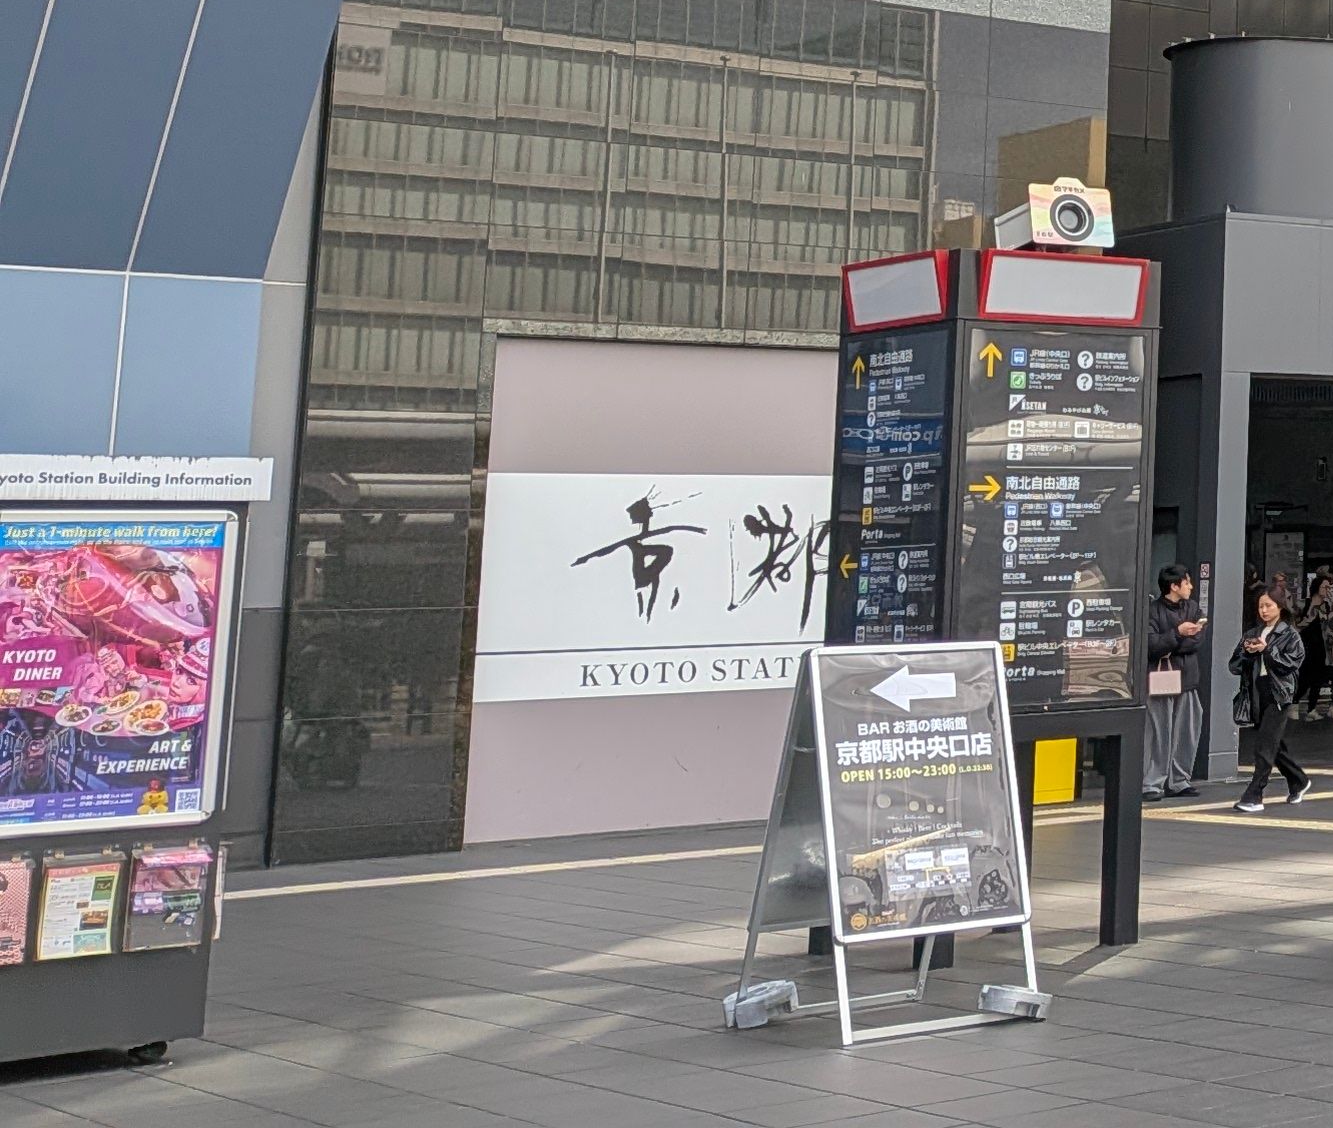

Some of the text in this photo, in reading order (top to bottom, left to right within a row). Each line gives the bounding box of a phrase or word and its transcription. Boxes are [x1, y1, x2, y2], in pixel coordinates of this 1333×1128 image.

[0, 472, 252, 488] yoto Station Building Information
[1006, 476, 1080, 491] 南北自由通路
[3, 649, 57, 664] KYOTO
[13, 667, 63, 682] DINER
[579, 655, 801, 688] KYOTO STAT
[857, 716, 968, 736] BAR お酒の美術館
[148, 739, 192, 754] ART &
[835, 732, 993, 766] 京都駅中央口店
[96, 757, 189, 775] EXPERIENCE
[841, 770, 875, 783] OPEN
